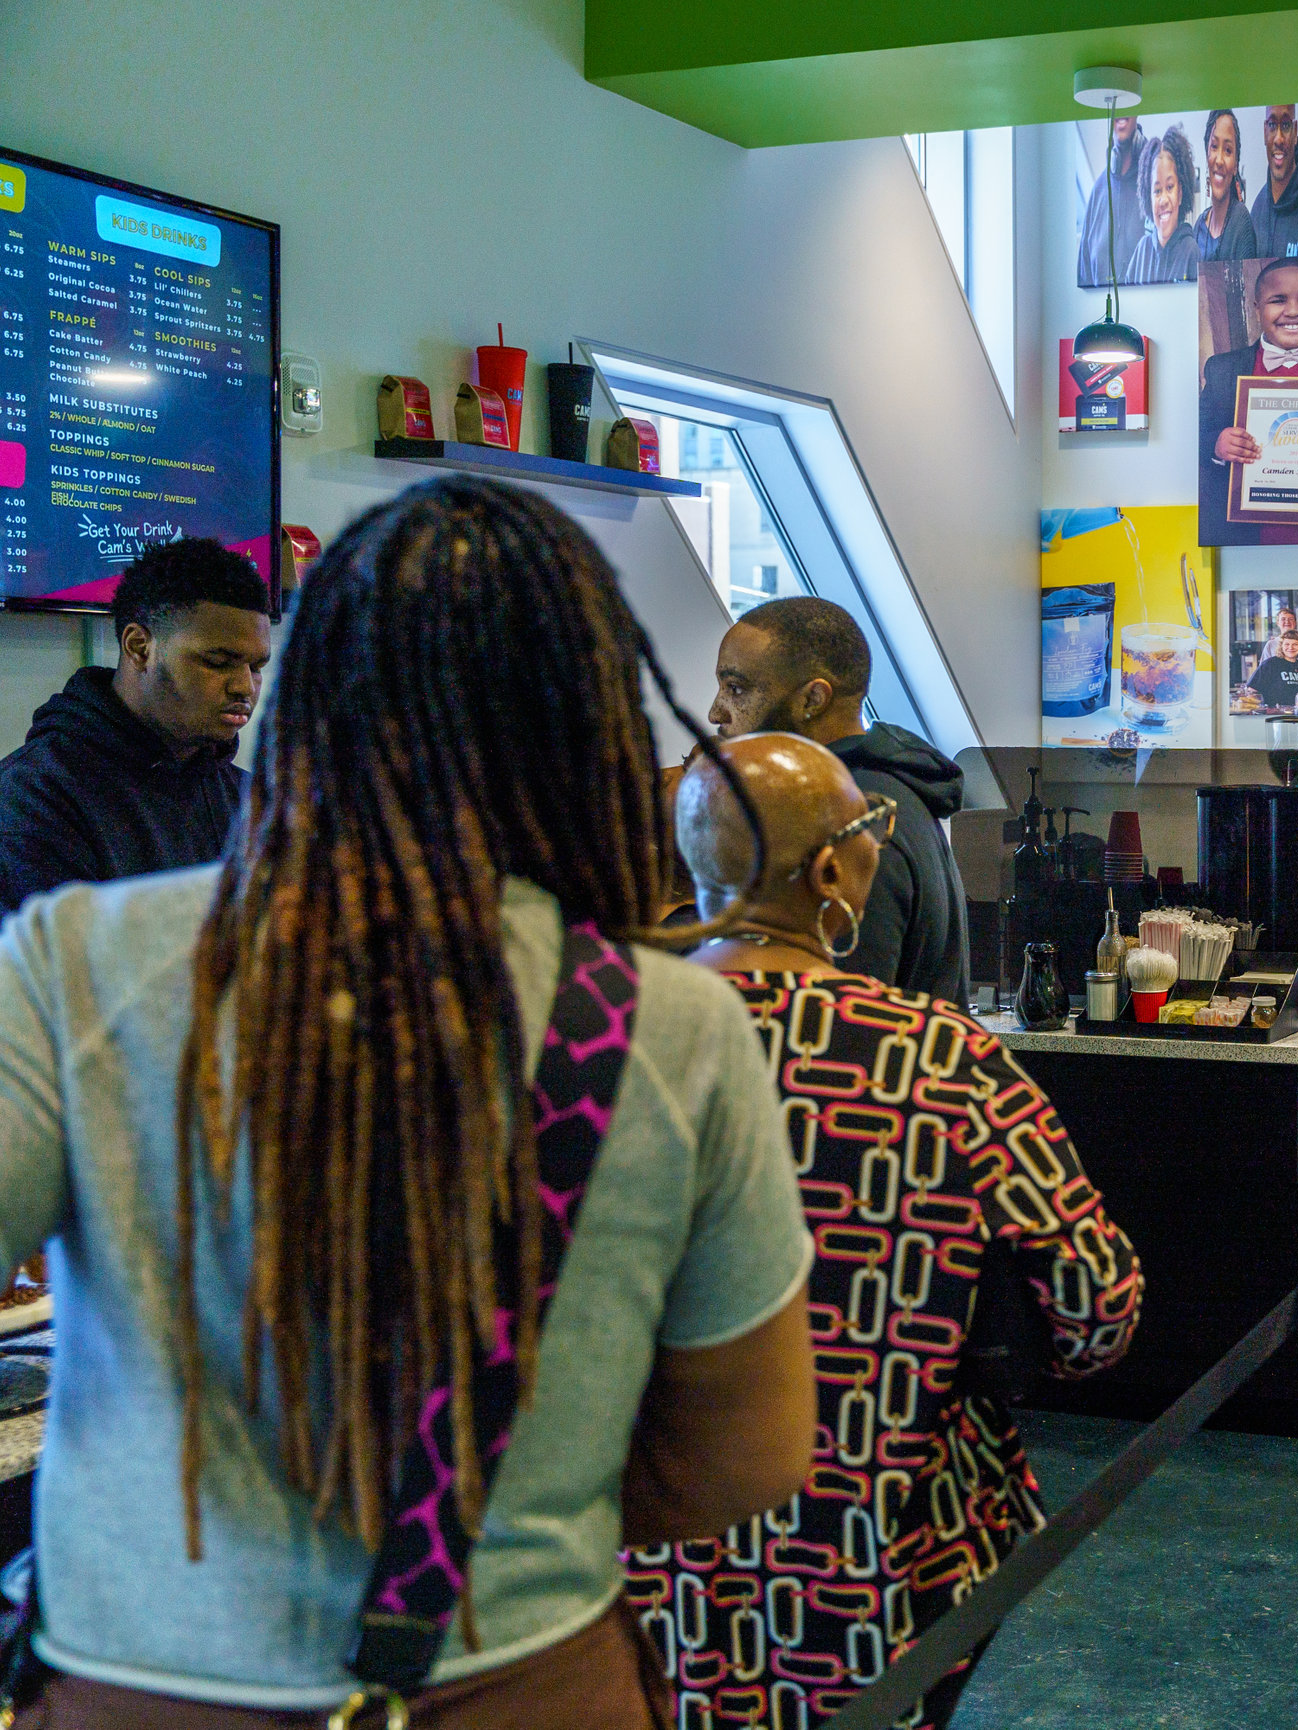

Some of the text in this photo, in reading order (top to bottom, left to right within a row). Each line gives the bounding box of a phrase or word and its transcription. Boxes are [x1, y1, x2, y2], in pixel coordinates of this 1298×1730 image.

[111, 212, 208, 251] KIDS DRINKS
[4, 243, 25, 255] 6.75
[48, 240, 117, 266] WARM SIPS
[48, 254, 91, 272] Steamers
[4, 267, 24, 278] 6.25
[129, 274, 147, 285] 3.75
[154, 266, 211, 288] COOL SIPS
[48, 272, 116, 294] Original Cocoa
[128, 290, 147, 301] 3.75
[154, 282, 202, 300] Lil' Chillers
[48, 288, 118, 310] Salted Caramel
[154, 297, 207, 315] Ocean Water
[226, 299, 242, 309] 3.75
[3, 311, 24, 322] 6.75
[129, 305, 147, 316] 3.75
[49, 309, 97, 328] FRAPPÉ
[154, 312, 221, 333] Sprout Spritzers
[226, 314, 242, 324] 3.75
[4, 330, 24, 341] 6.75
[49, 329, 104, 346] Cake Batter
[154, 331, 217, 352] SMOOTHIES
[226, 328, 265, 343] 3.75 4.75
[4, 347, 24, 359] 6.75
[49, 345, 112, 365] Cotton Candy
[129, 343, 147, 353] 4.75
[155, 348, 201, 365] Strawberry
[49, 360, 82, 373] Peanut
[129, 361, 147, 370] 4.75
[155, 363, 208, 380] White Peach
[226, 361, 243, 371] 4.25
[49, 372, 96, 387] Chocolate
[226, 377, 243, 387] 4.25
[6, 392, 26, 402] 3.50
[1260, 399, 1278, 408] THE
[7, 407, 27, 418] 5.75
[49, 393, 158, 419] MILK SUBSTITUTES
[7, 422, 26, 432] 6.25
[49, 410, 156, 434] 2% WHOLE ALMOND OAT
[49, 429, 110, 447] TOPPINGS
[50, 443, 215, 473] CLASSIC WHIP SOFT TOP CINNAMON SUGAR
[51, 465, 141, 485] KIDS TOPPINGS
[1262, 467, 1294, 475] Camden
[51, 481, 197, 505] SPRINKLES COTTON CANDY SWEDISH
[4, 498, 26, 507] 4.00
[51, 498, 123, 512] CHOCOLATE CHIPS
[5, 515, 27, 525] 4.00
[7, 529, 27, 539] 2.75
[88, 520, 174, 538] Get Your Drink
[6, 548, 27, 557] 3.00
[97, 539, 132, 555] Cam's
[7, 565, 27, 574] 2.75
